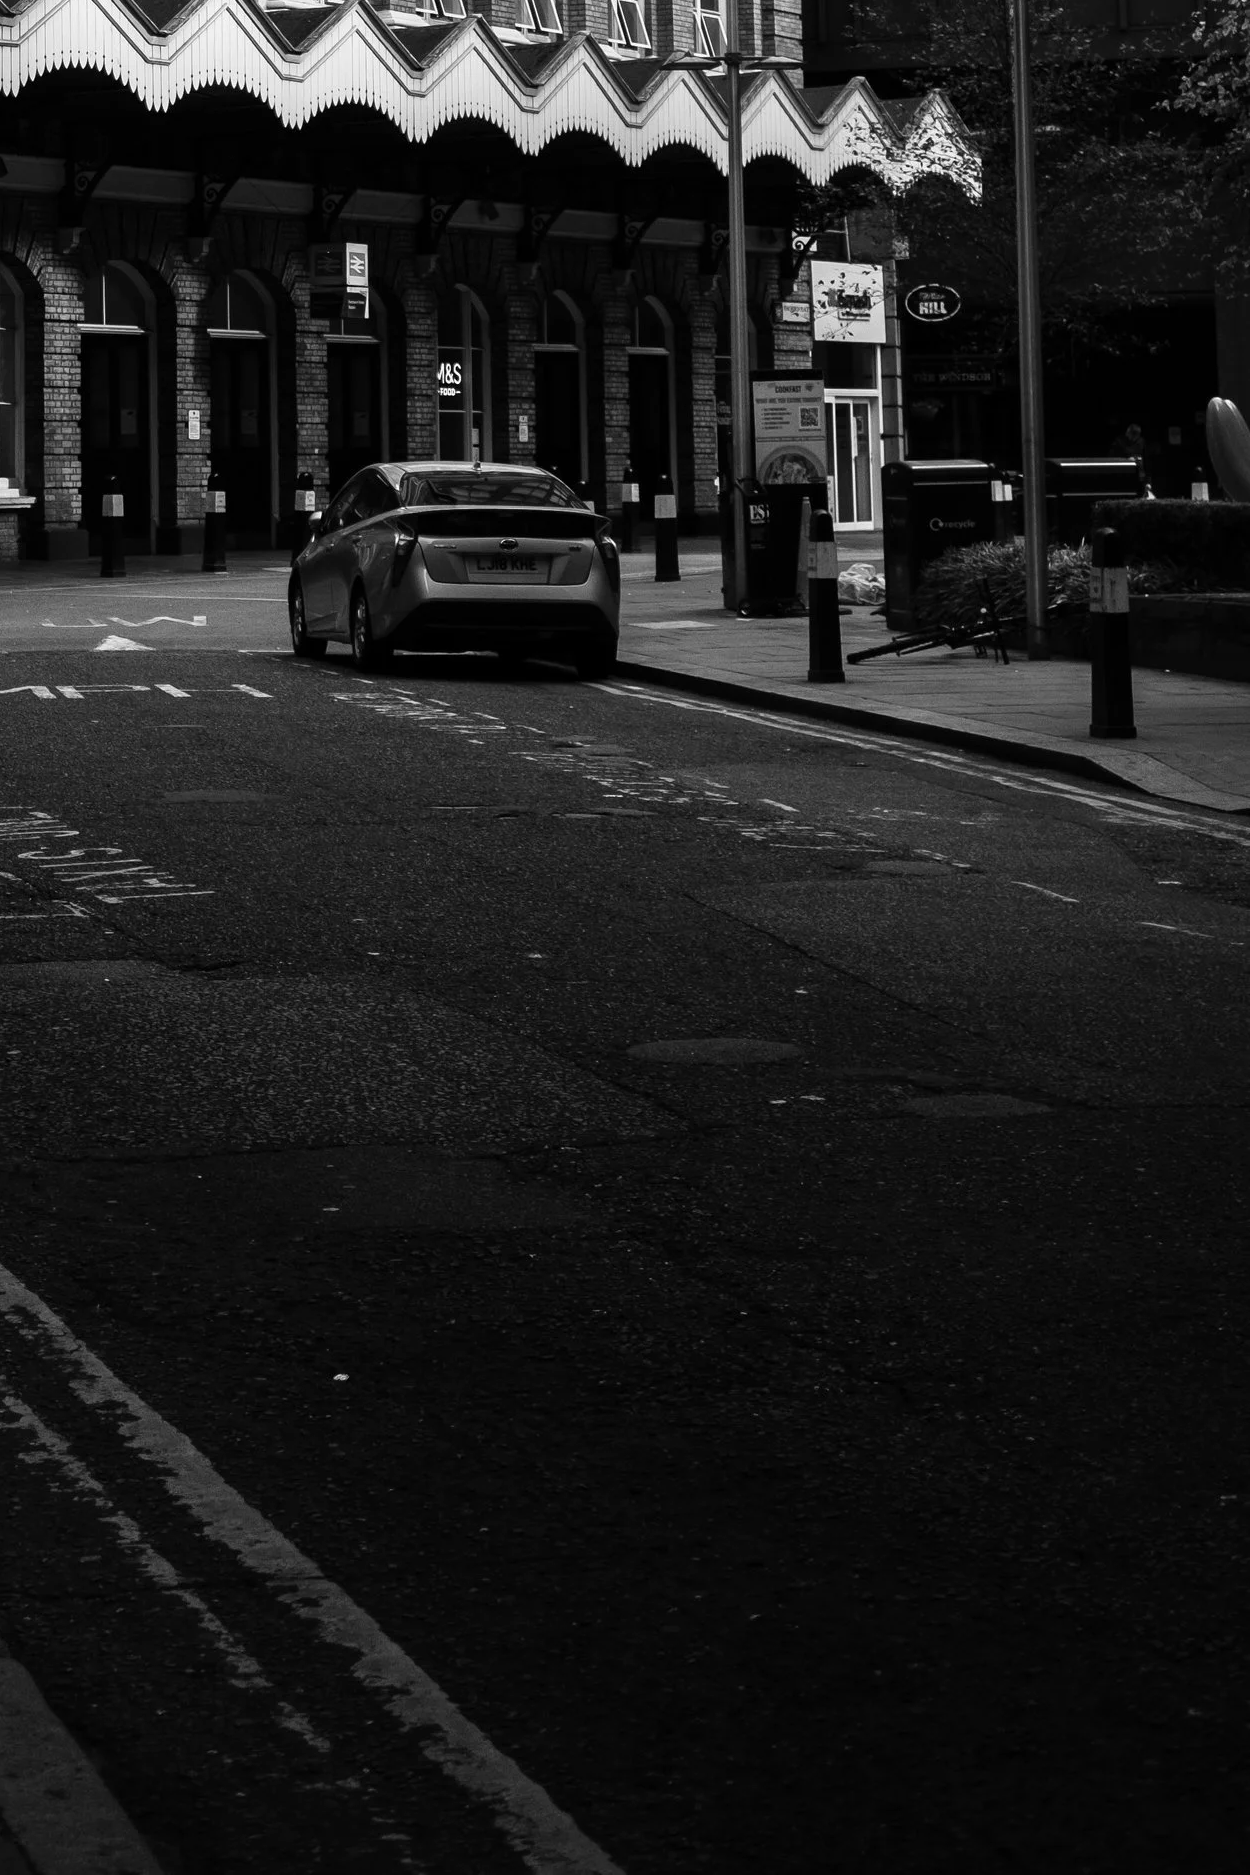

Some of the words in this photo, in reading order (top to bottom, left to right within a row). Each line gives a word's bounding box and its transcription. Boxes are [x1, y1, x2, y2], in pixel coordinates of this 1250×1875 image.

[919, 301, 947, 315] HILL
[436, 362, 462, 385] M&S
[943, 518, 976, 530] recycle
[511, 559, 538, 571] KHE
